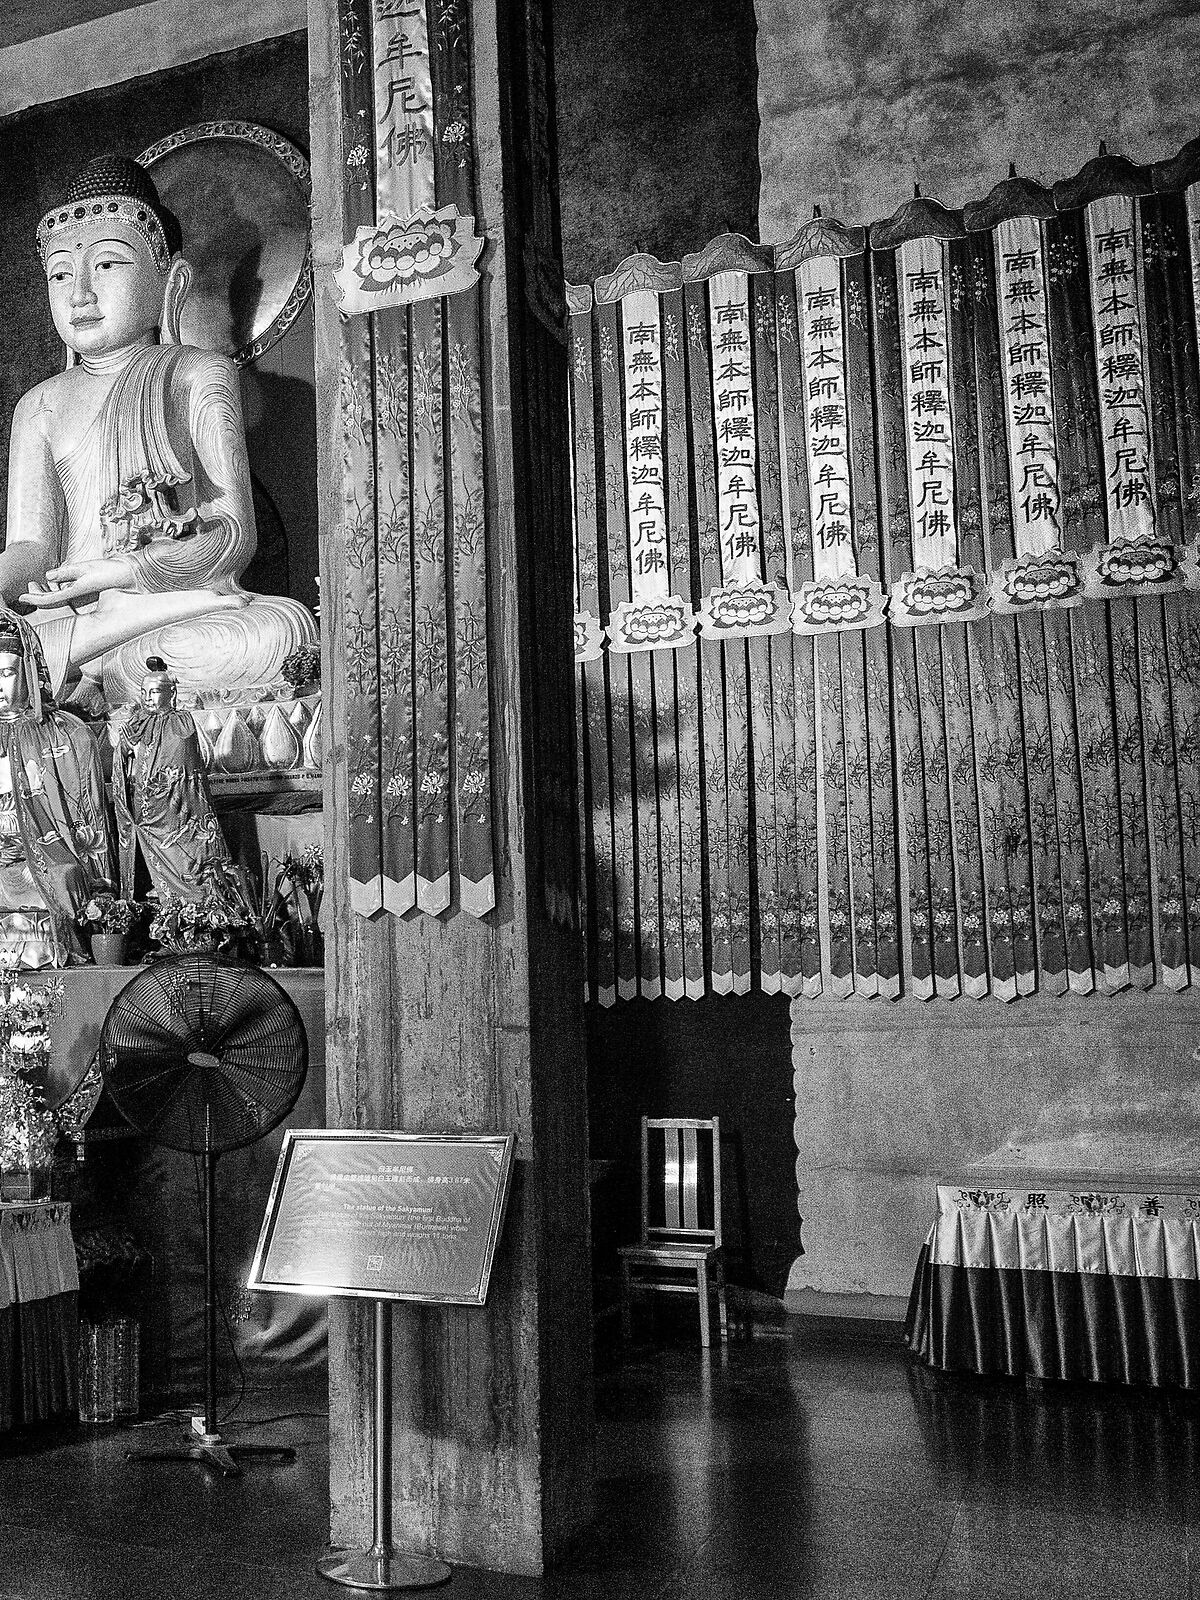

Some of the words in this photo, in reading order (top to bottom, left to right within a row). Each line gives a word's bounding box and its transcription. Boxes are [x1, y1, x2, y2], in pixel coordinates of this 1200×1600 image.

[627, 321, 667, 576] 南無本師釋迦牟尼佛
[714, 302, 757, 559] 南無本師釋迦牟尼佛
[805, 285, 848, 550] 南無本師釋迦牟尼佛
[906, 268, 951, 539] 南無本師釋迦牟尼佛
[1003, 247, 1053, 524] 南無本師釋迦牟尼佛
[1095, 226, 1148, 508] 南無本師釋迦牟尼佛
[1024, 1193, 1049, 1209] 照
